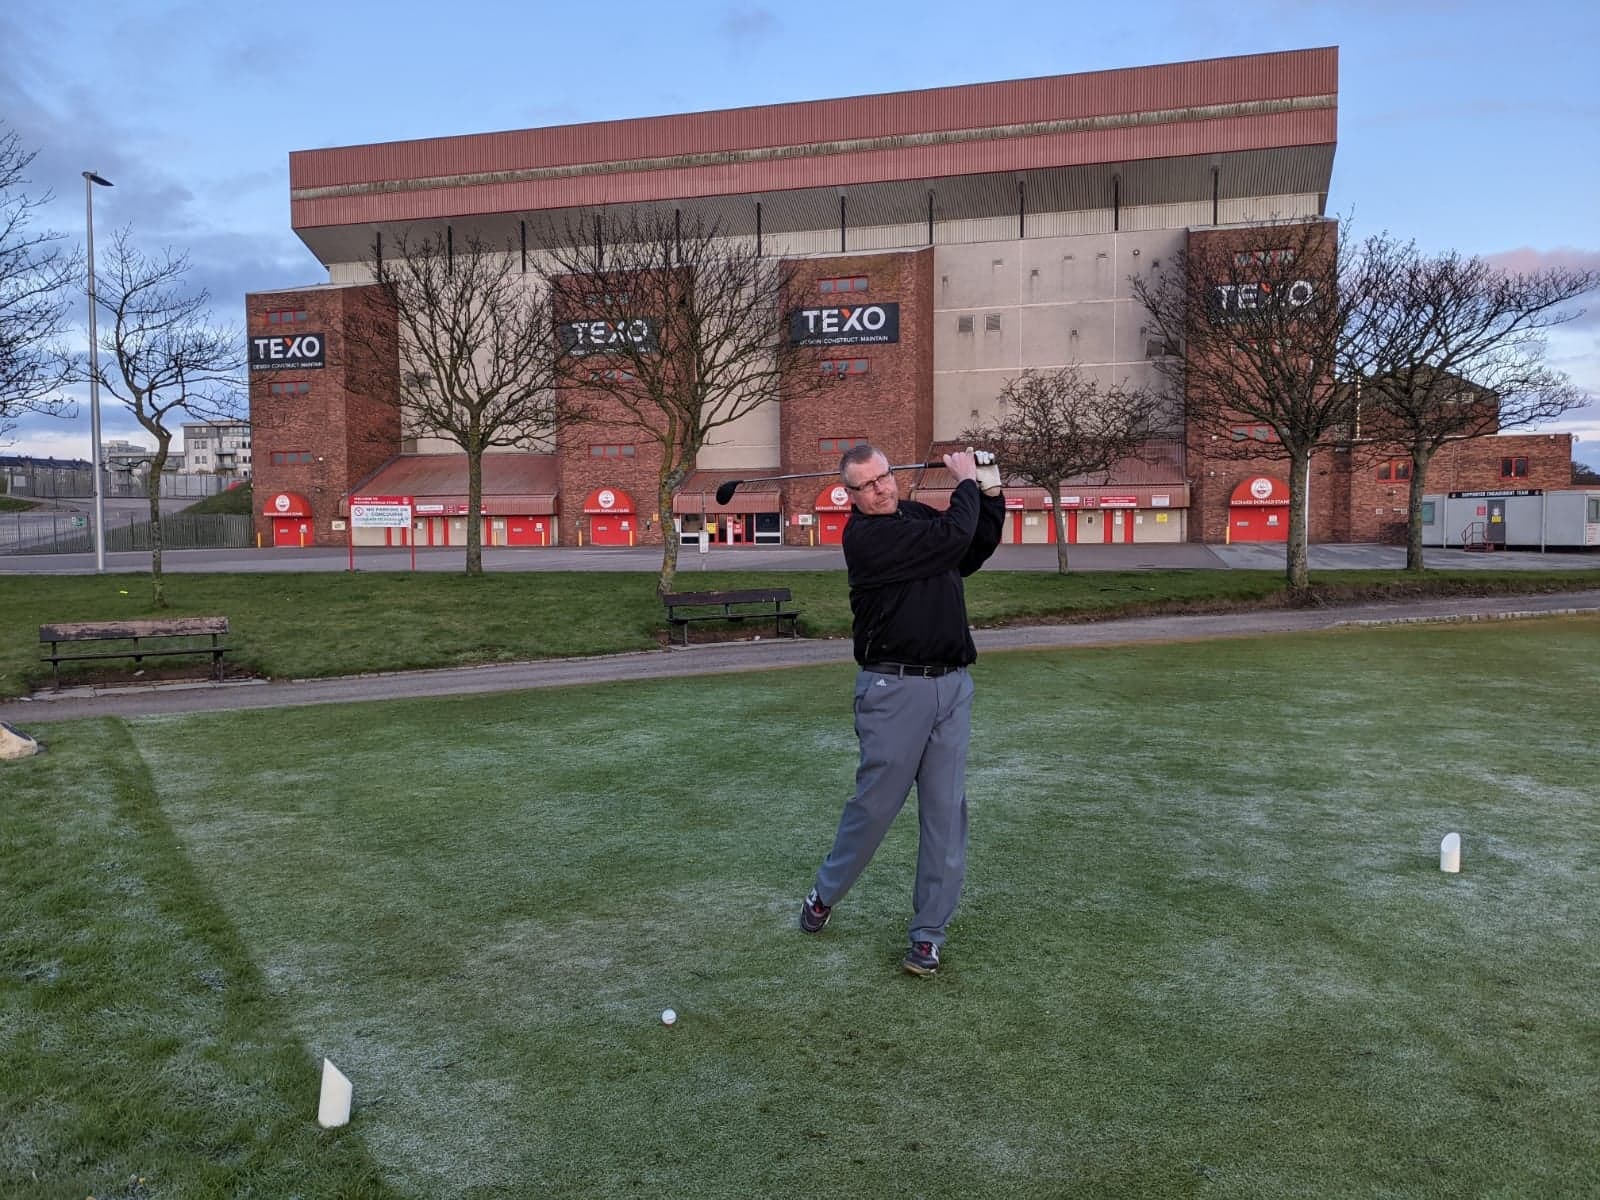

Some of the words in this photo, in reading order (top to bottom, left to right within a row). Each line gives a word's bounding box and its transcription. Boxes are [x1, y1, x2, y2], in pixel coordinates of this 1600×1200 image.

[802, 306, 886, 333] TEXO
[572, 320, 648, 344] TEXO
[823, 336, 859, 345] CONSTRUCT
[860, 335, 889, 343] MAINTAIN
[254, 336, 320, 359] TEXO
